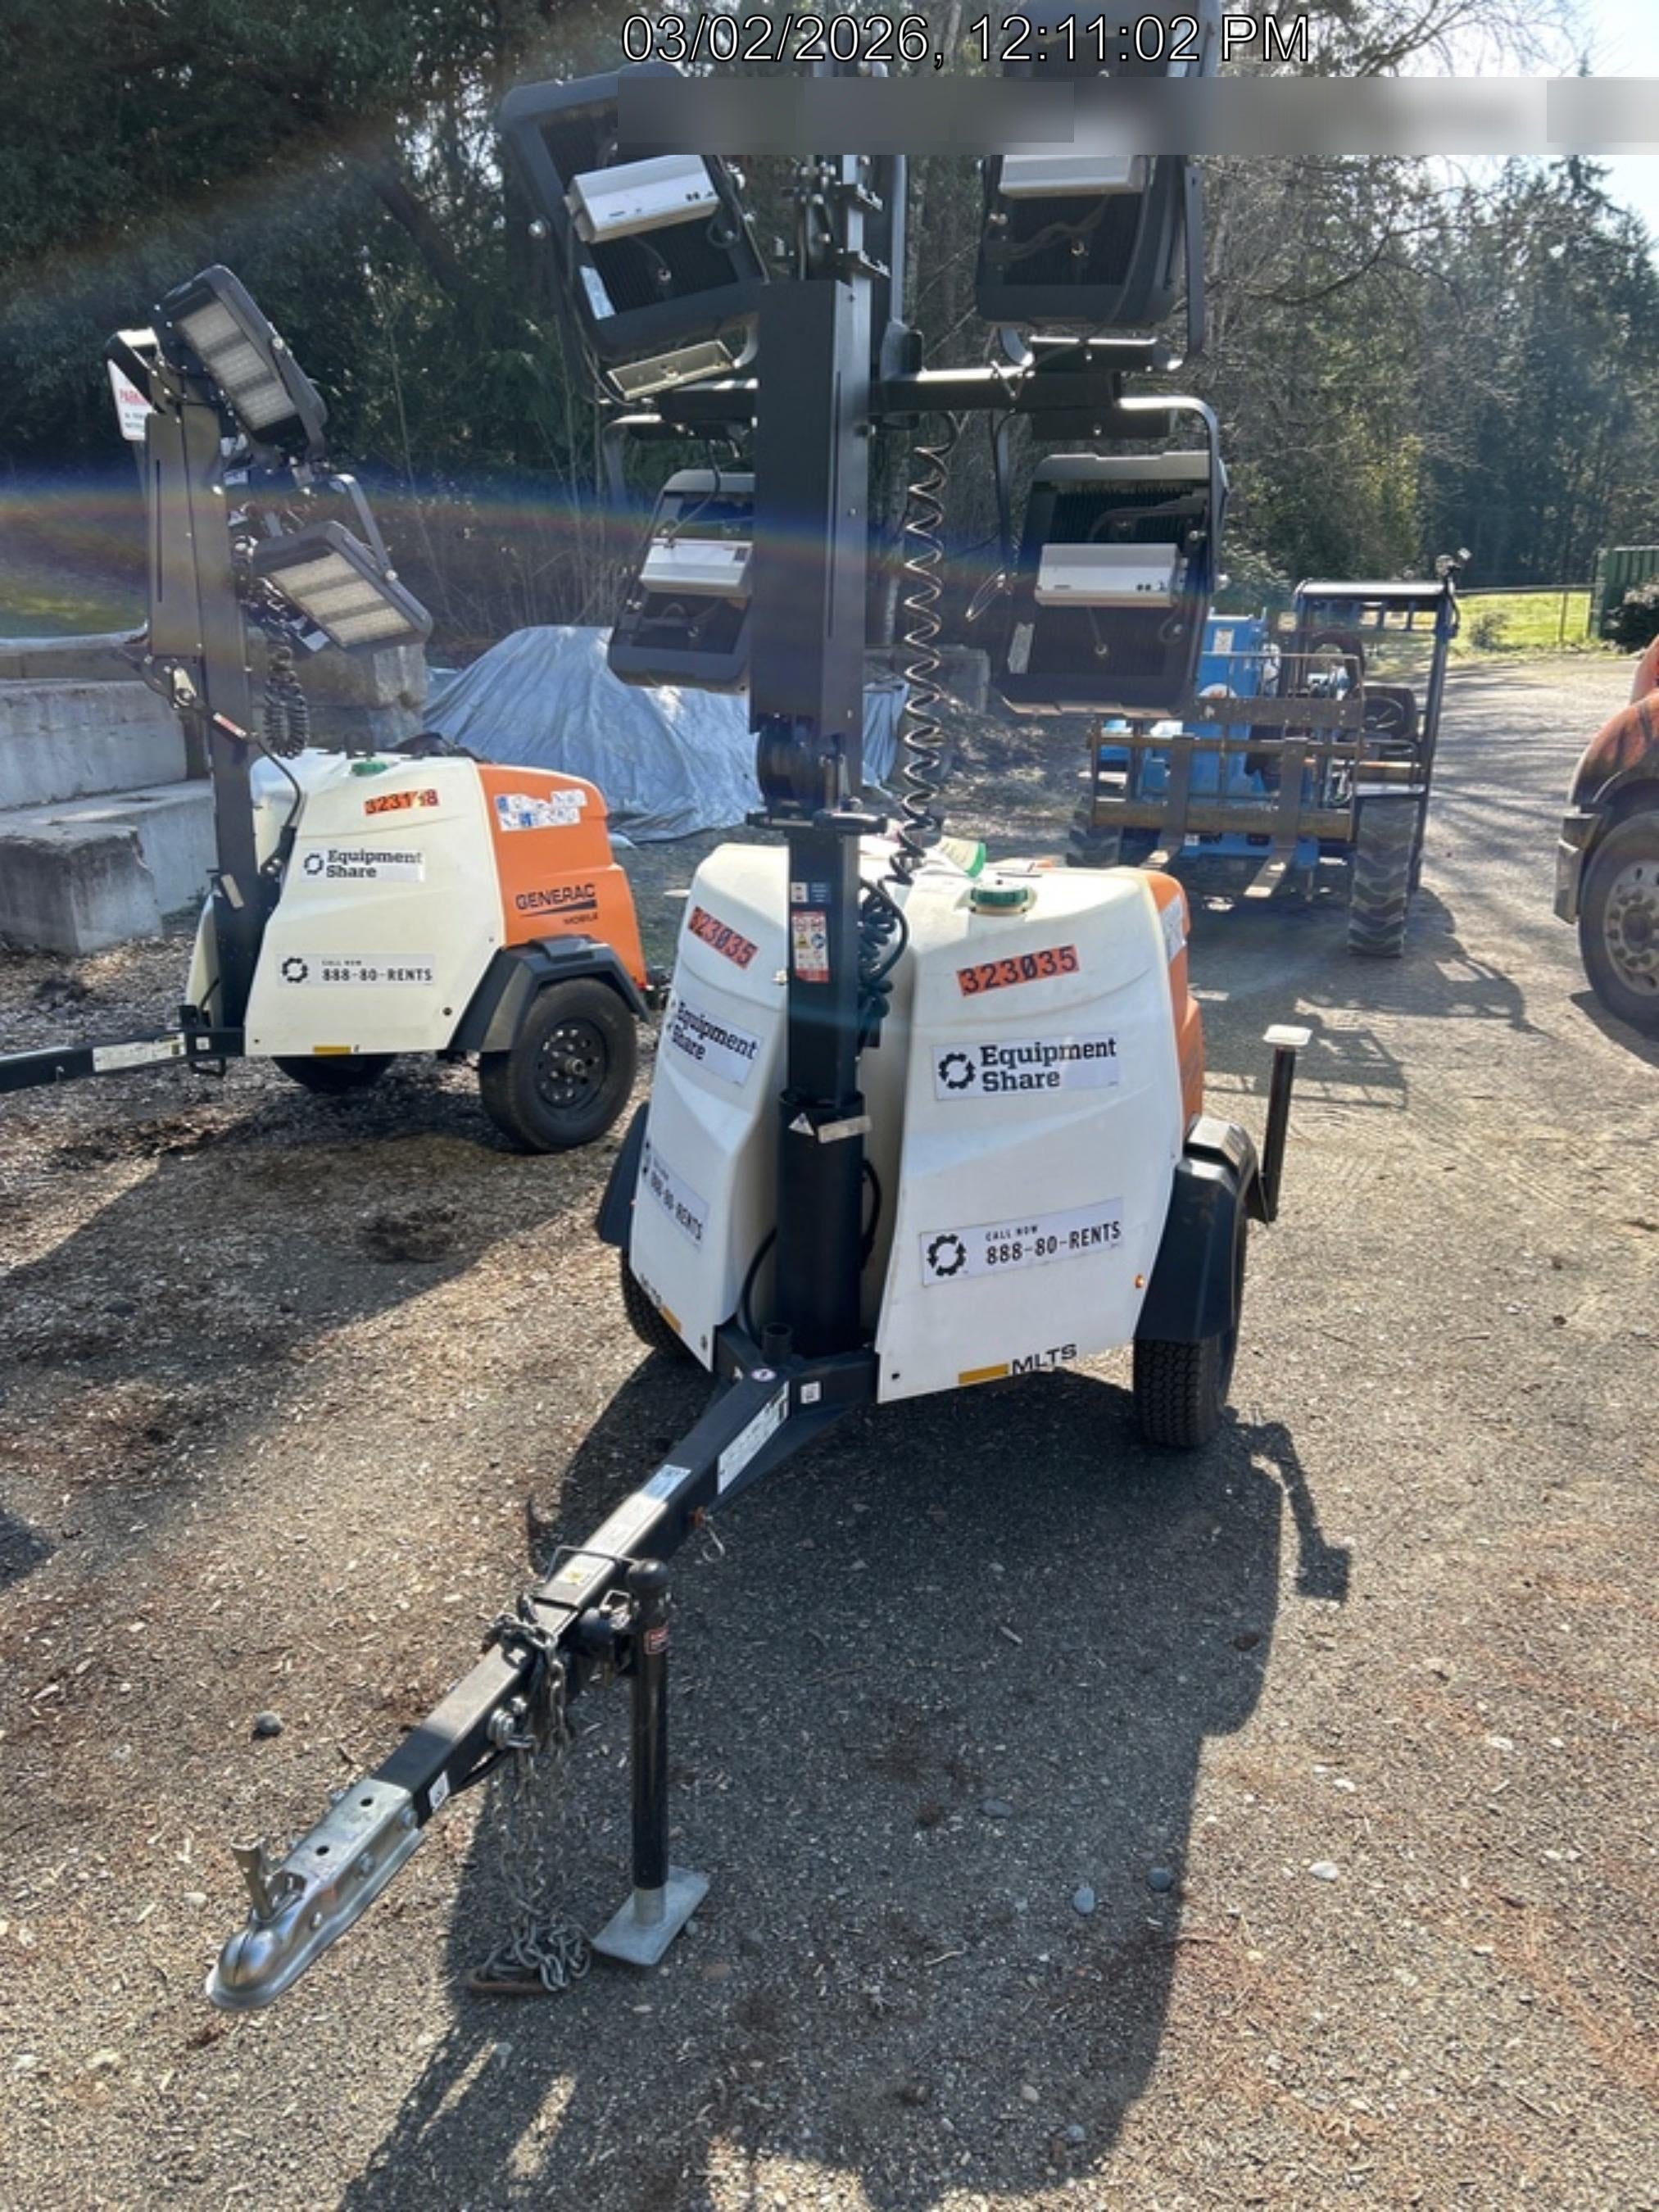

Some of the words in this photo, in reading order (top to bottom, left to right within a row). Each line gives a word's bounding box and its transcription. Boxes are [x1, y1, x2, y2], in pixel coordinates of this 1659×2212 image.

[326, 864, 377, 878] Share
[329, 848, 423, 865] Equipment
[515, 883, 596, 910] GENERAC
[323, 968, 433, 982] 888-80-RENTS
[959, 945, 1078, 994] 323035
[672, 1023, 705, 1060] Share
[678, 1001, 758, 1060] Equipment
[980, 1037, 1117, 1070] Equipment
[982, 1071, 1060, 1092] Share
[986, 1229, 1011, 1242] CALL
[1017, 1226, 1038, 1236] NOW
[986, 1221, 1121, 1265] 888-80-RENTS
[1013, 1344, 1077, 1377] MLTS
